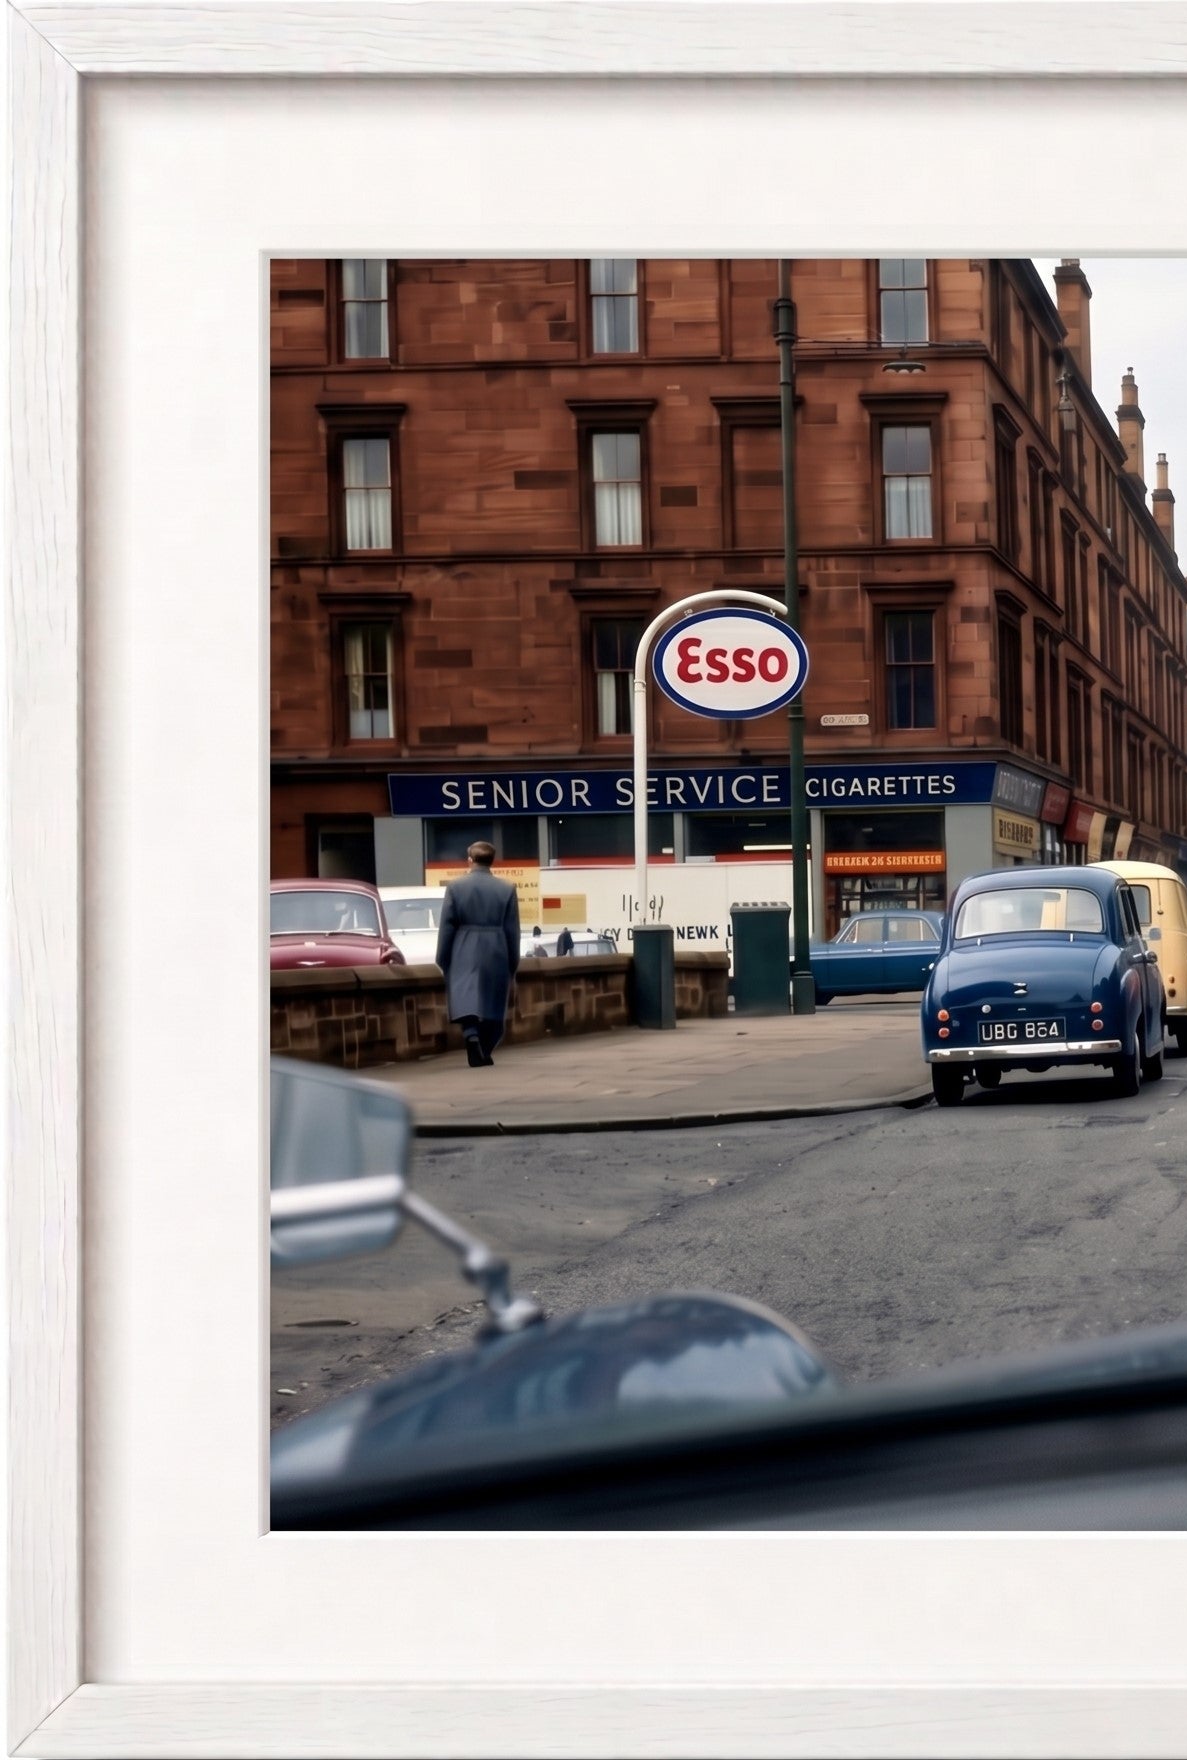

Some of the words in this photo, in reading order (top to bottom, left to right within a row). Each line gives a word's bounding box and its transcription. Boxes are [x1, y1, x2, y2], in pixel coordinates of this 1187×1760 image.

[677, 637, 789, 684] Esso
[441, 778, 592, 810] SENIOR
[615, 775, 781, 806] SERVICE
[805, 775, 956, 798] CIGARETTES
[981, 1023, 1018, 1041] UBG
